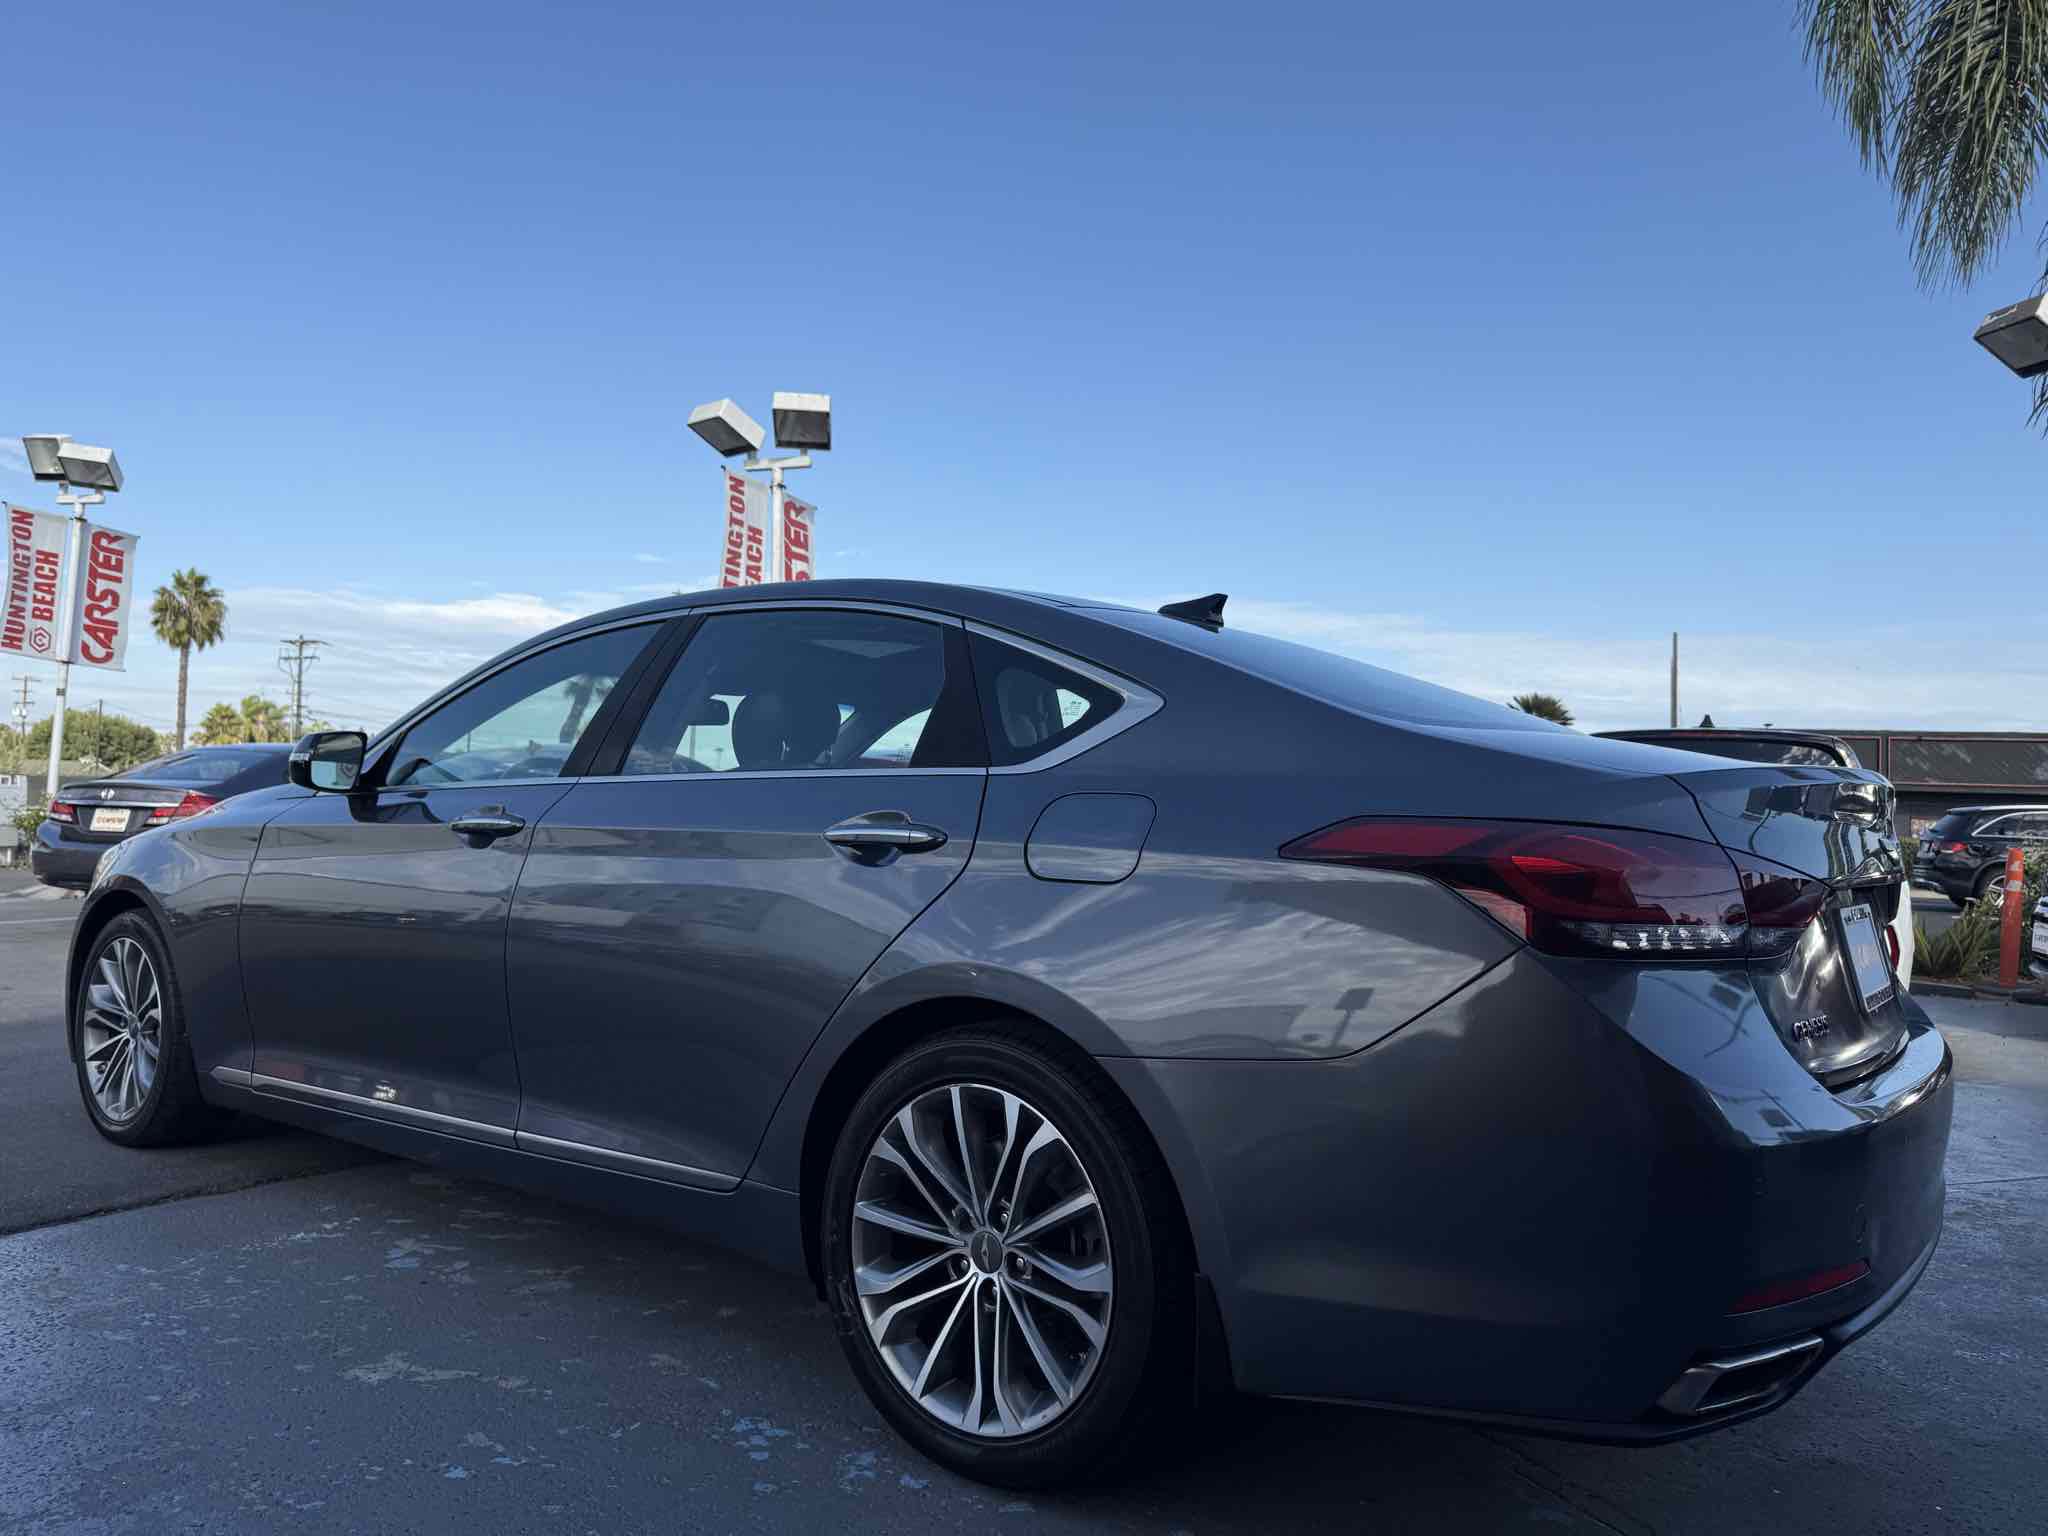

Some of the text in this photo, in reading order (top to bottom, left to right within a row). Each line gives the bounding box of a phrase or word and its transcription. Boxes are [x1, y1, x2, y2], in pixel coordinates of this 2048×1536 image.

[1, 509, 35, 651] HUNTINGTON
[722, 474, 746, 588] TINGTON
[745, 525, 763, 584] ACH
[784, 499, 810, 582] STER
[31, 549, 59, 622] BEACH
[81, 529, 126, 665] CARSTER
